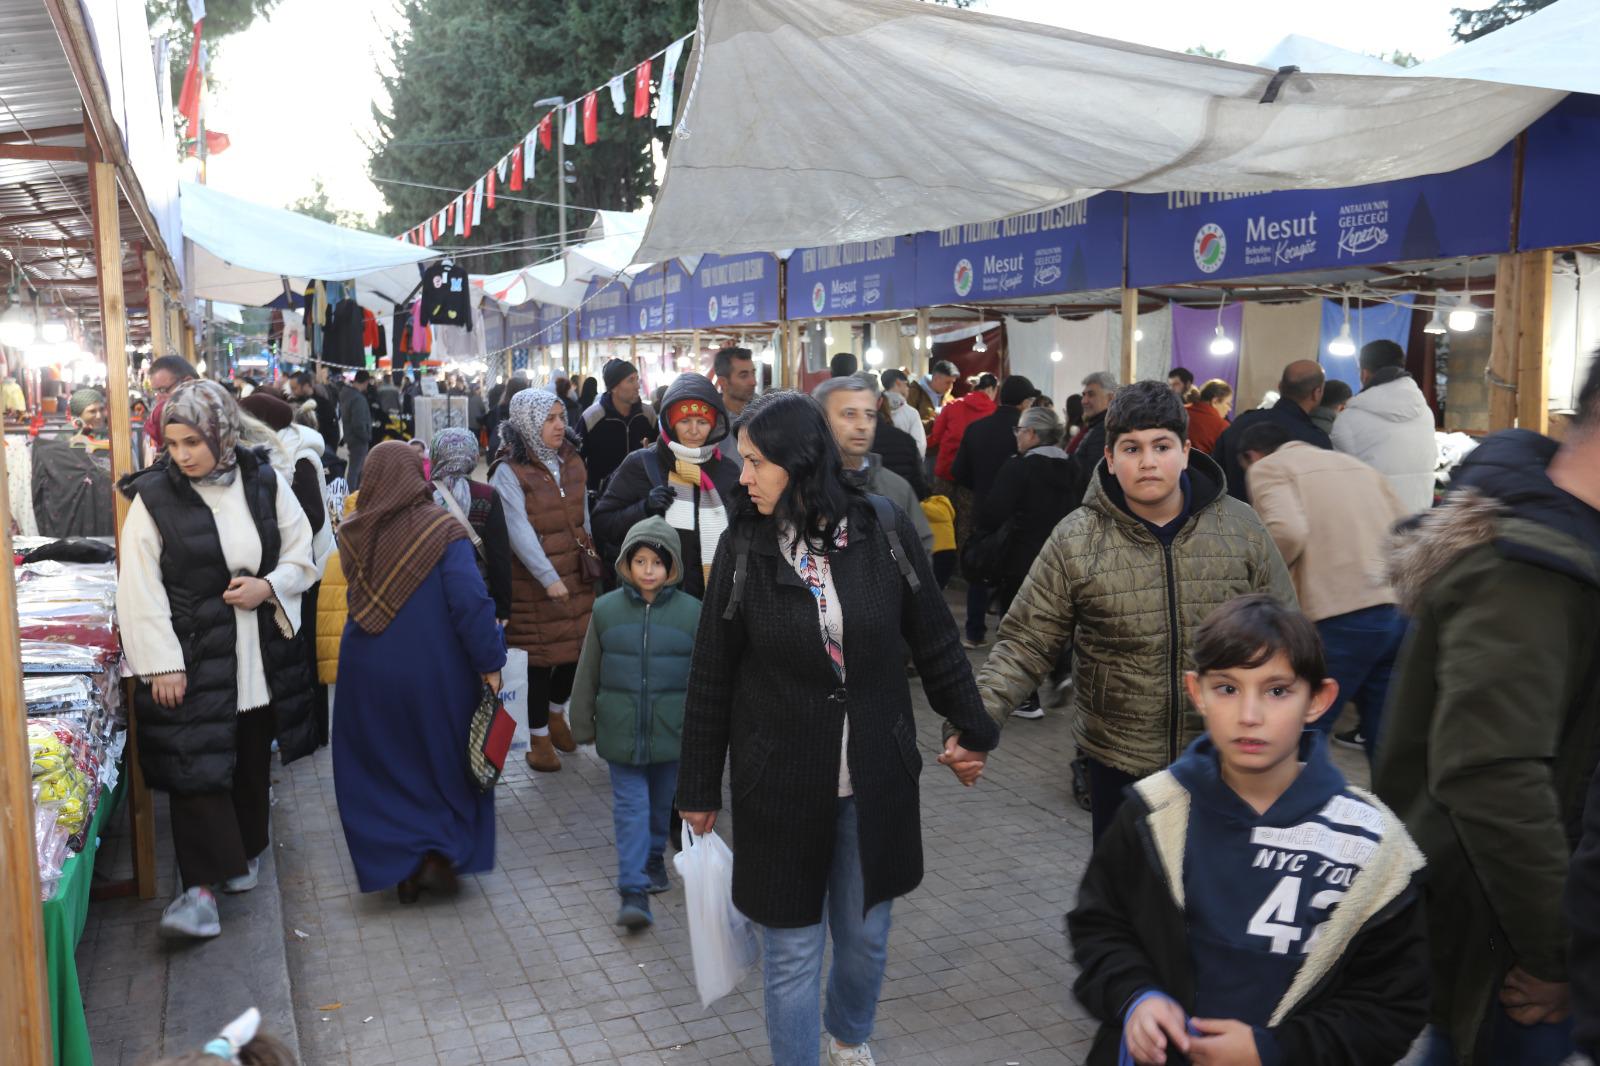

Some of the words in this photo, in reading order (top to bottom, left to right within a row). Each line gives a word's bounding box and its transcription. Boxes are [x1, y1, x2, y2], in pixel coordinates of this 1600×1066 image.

[1246, 211, 1318, 243] Mesut
[983, 253, 1024, 275] Mesut
[1252, 848, 1308, 873] NYC
